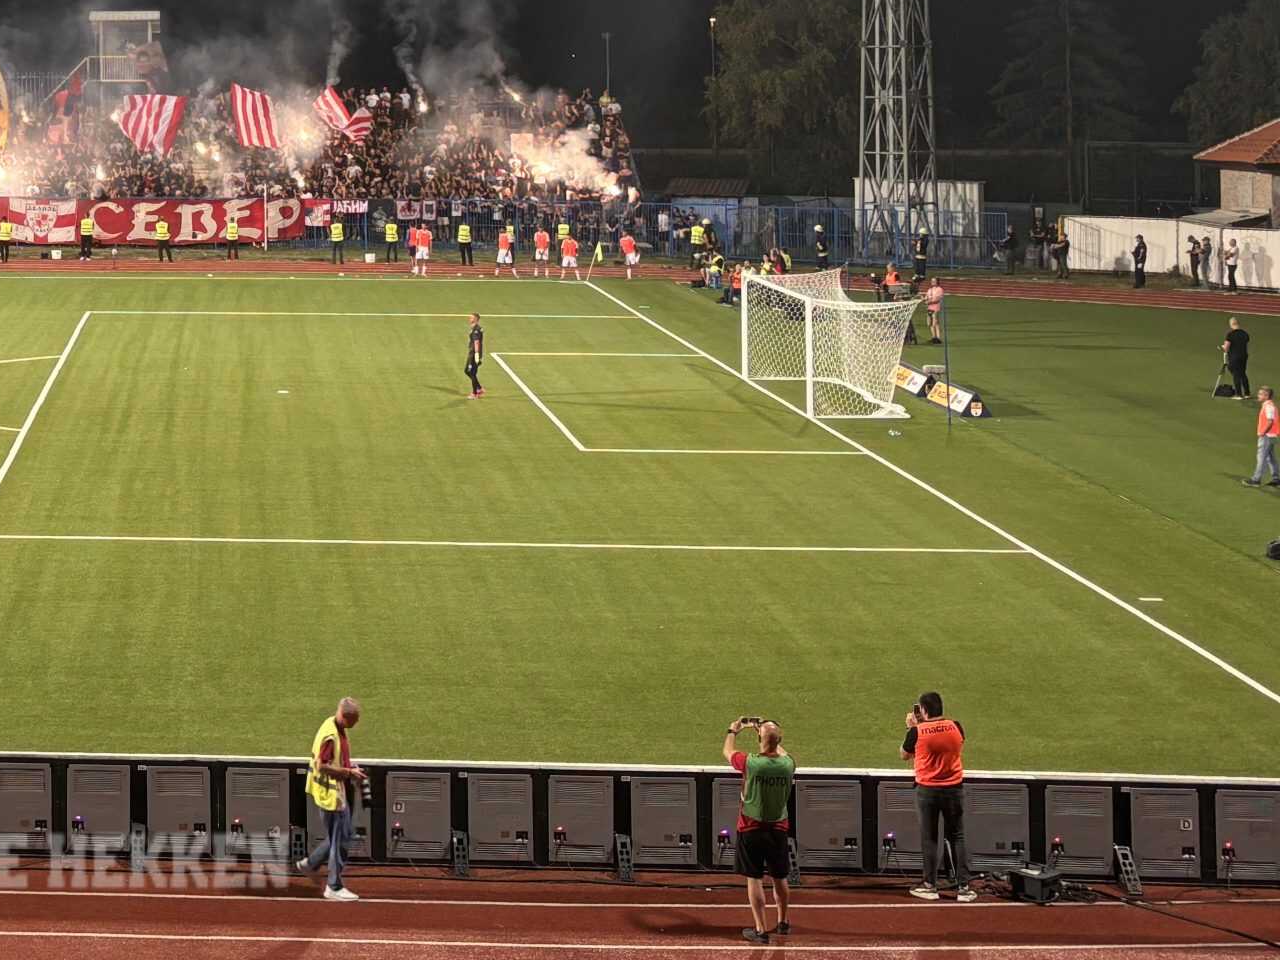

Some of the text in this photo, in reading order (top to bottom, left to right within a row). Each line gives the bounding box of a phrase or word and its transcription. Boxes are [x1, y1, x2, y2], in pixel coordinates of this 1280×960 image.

[90, 198, 301, 241] СЕВЕР
[921, 724, 956, 735] macron
[754, 775, 788, 785] PHOTO
